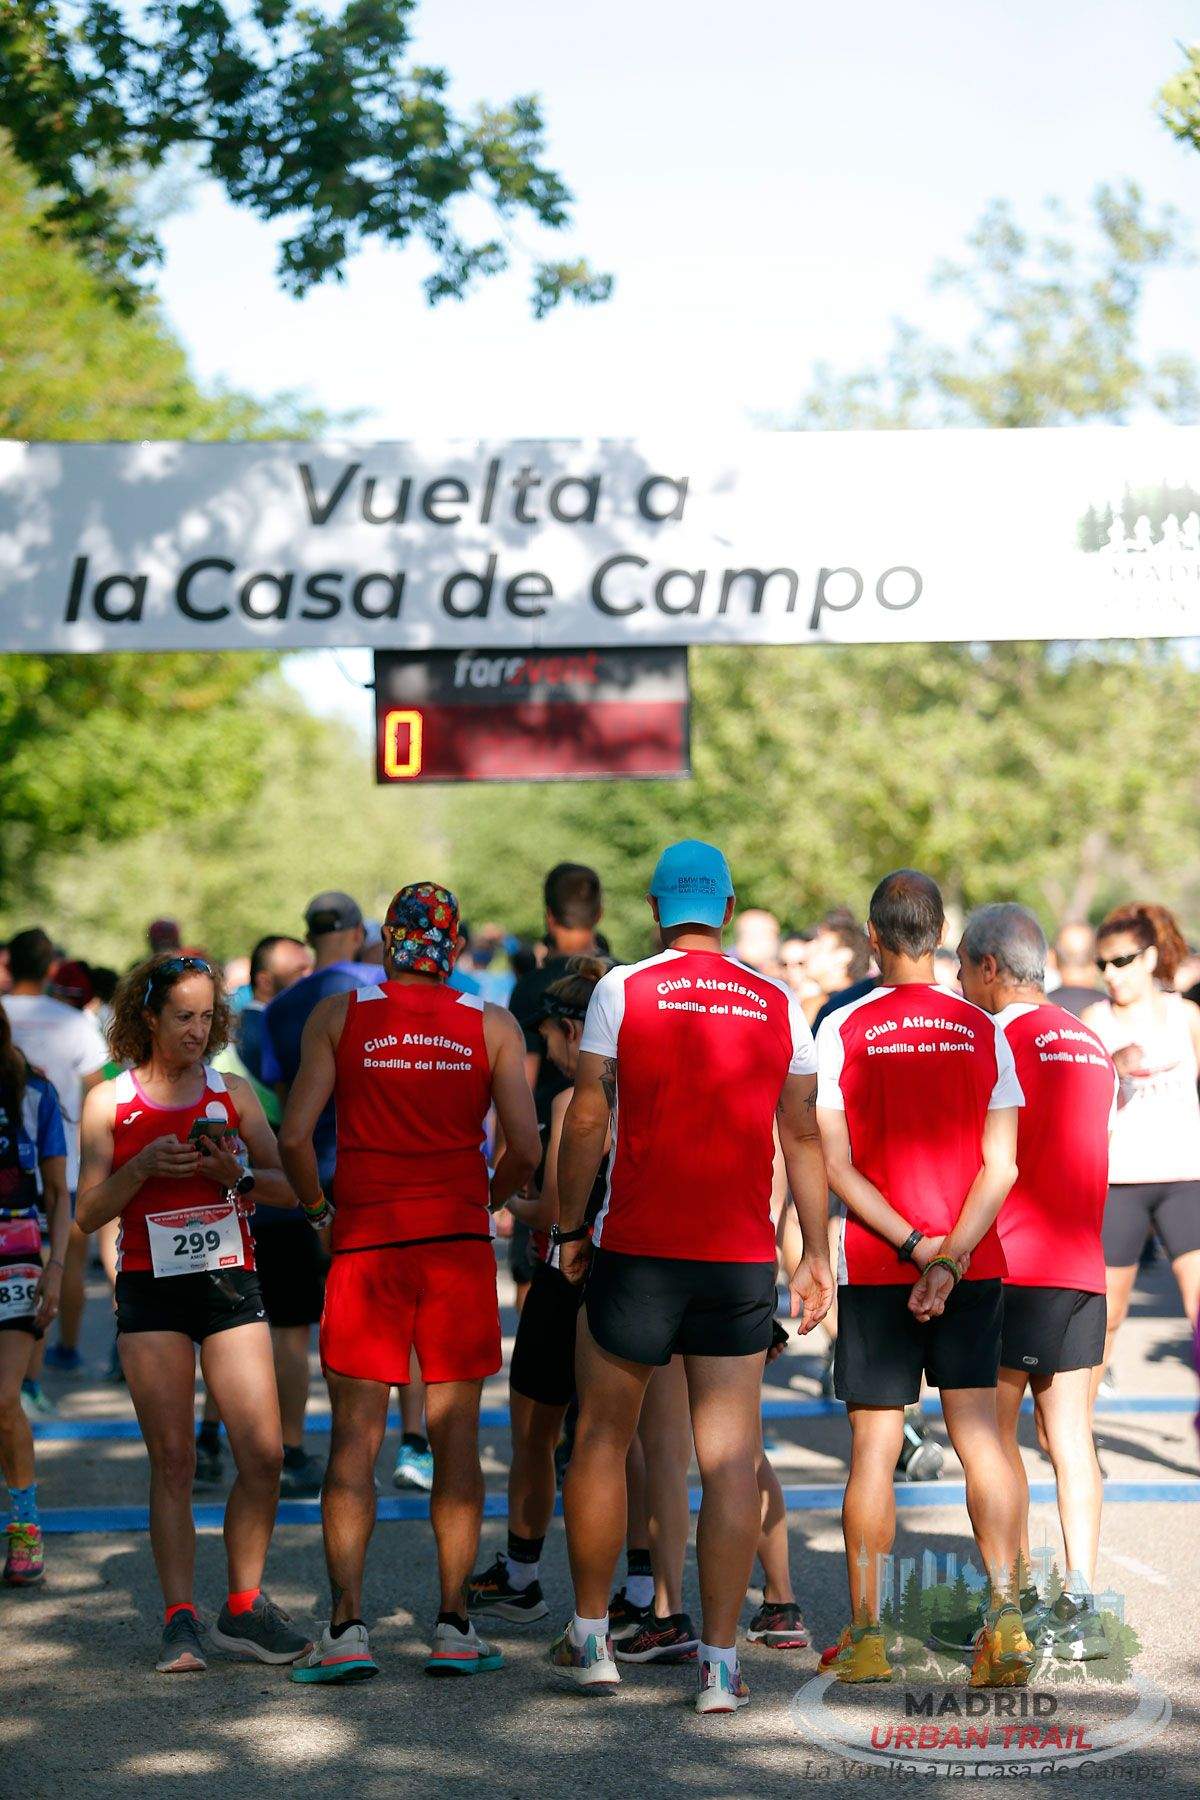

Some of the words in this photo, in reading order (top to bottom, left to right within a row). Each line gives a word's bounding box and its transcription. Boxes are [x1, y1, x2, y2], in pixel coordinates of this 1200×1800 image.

[298, 458, 601, 525] Vuelta
[637, 475, 689, 522] a
[64, 556, 148, 623] la
[175, 557, 406, 622] Casa
[442, 554, 554, 618] de
[592, 554, 923, 630] Campo
[384, 710, 424, 778] 0
[656, 977, 692, 995] Club
[695, 978, 768, 1008] Atletismo
[657, 1000, 707, 1013] Boadilla
[709, 1004, 729, 1015] del
[731, 1005, 768, 1022] Monte
[864, 1020, 898, 1041] Club
[902, 1015, 976, 1039] Atletismo
[363, 1034, 398, 1053] Club
[402, 1033, 473, 1057] Atletismo
[866, 1043, 915, 1056] Boadilla
[917, 1042, 936, 1053] del
[939, 1041, 976, 1053] Monte
[363, 1058, 412, 1070] Boadilla
[414, 1060, 433, 1071] del
[435, 1061, 473, 1071] Monte
[172, 1230, 221, 1256] 299
